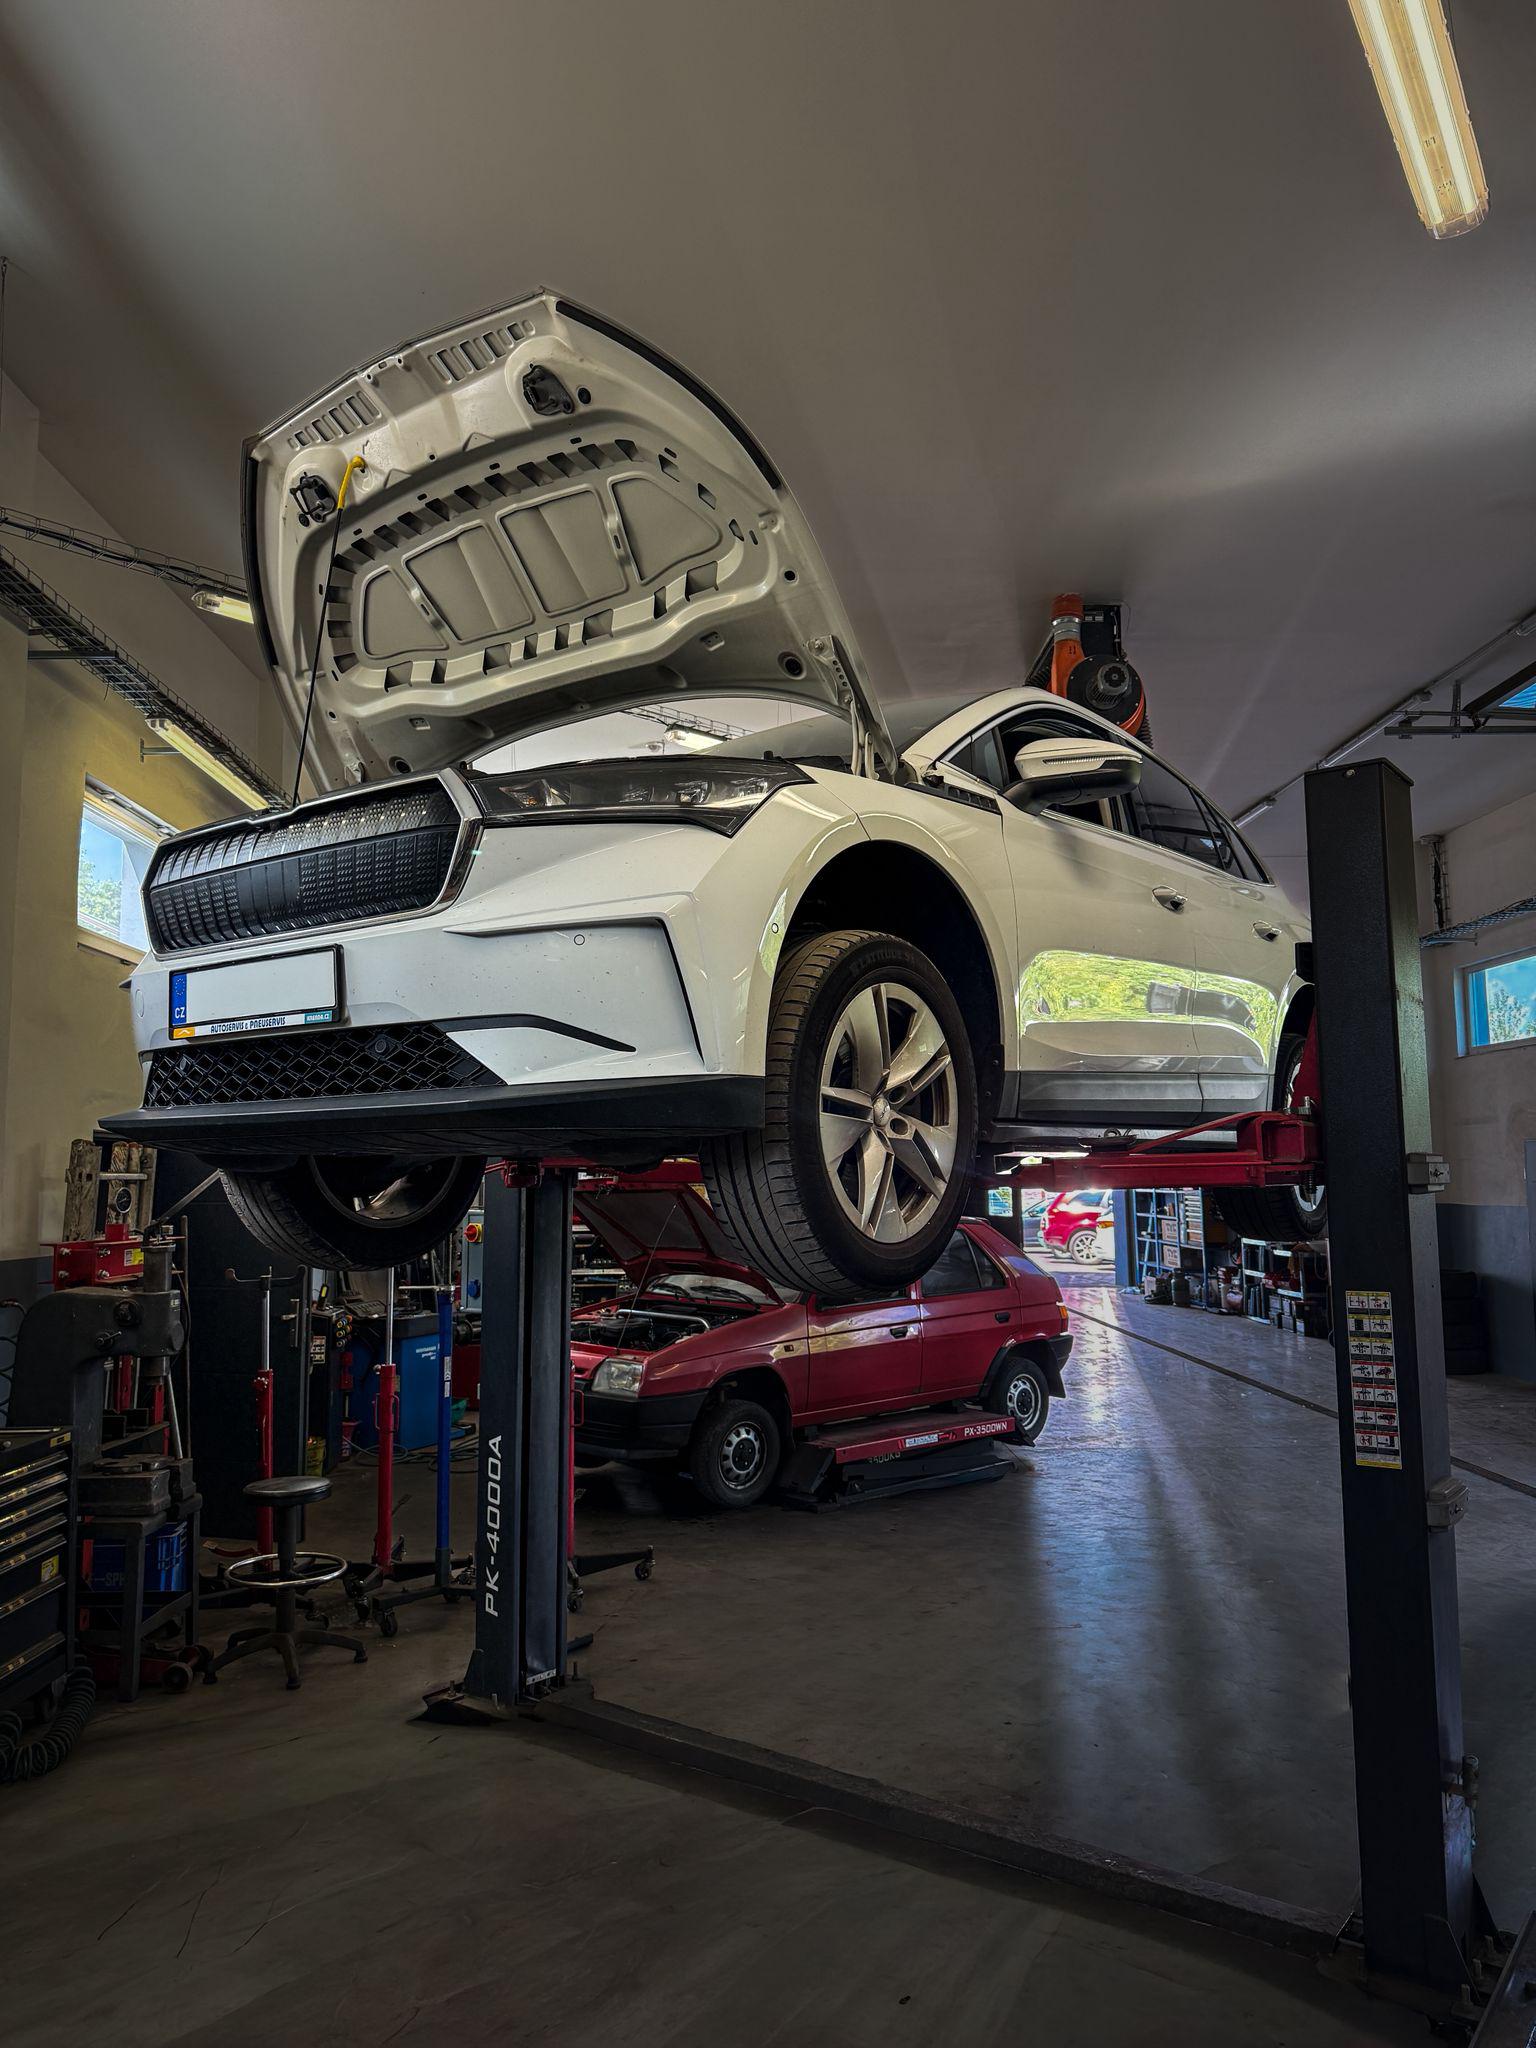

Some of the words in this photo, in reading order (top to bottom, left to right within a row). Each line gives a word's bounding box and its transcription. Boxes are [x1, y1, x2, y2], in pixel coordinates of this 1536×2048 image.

[174, 1006, 185, 1019] CZ
[210, 1021, 244, 1034] AUTOSERVIS
[249, 1016, 286, 1030] PNEUSERVIS
[964, 1421, 1008, 1437] PX-3500WN
[484, 1434, 502, 1617] PK-4000A
